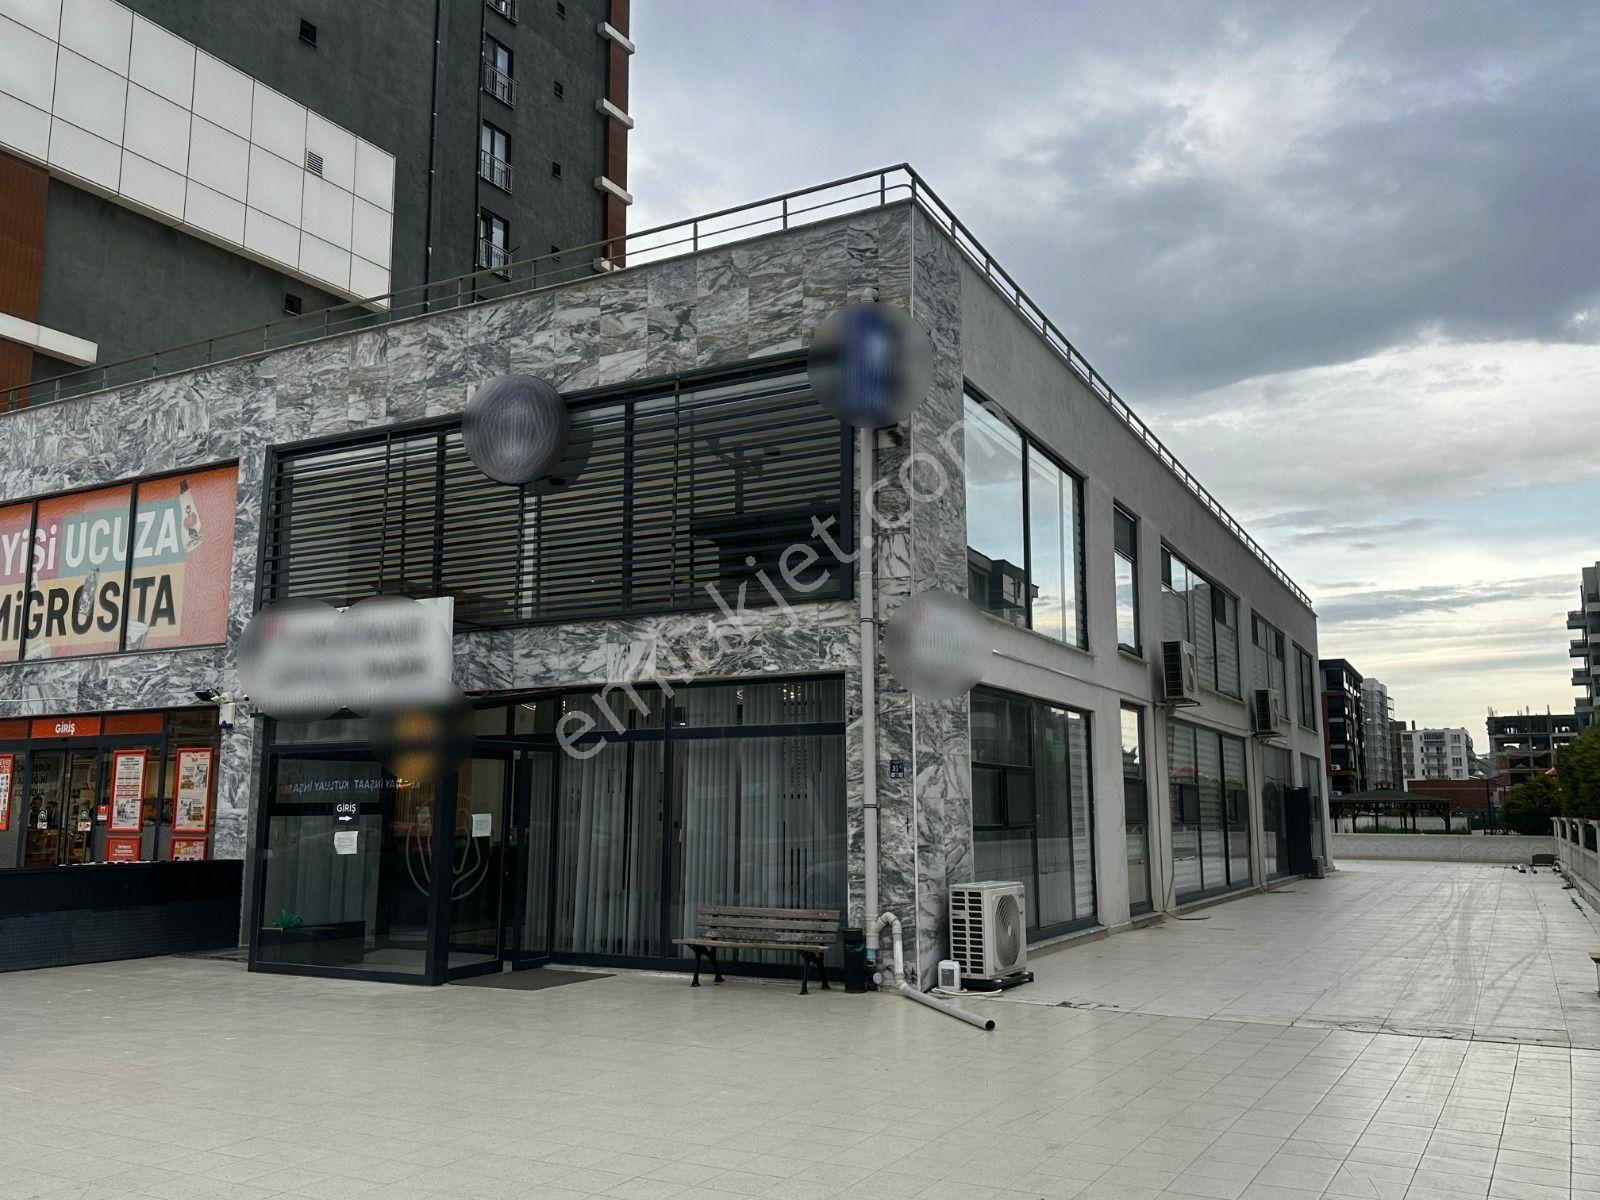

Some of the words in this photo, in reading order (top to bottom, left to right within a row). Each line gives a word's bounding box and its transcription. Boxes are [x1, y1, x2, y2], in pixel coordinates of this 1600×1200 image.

[65, 507, 179, 568] UCUZA
[55, 721, 75, 735] GİRİŞ
[336, 802, 357, 814] GİRİŞ
